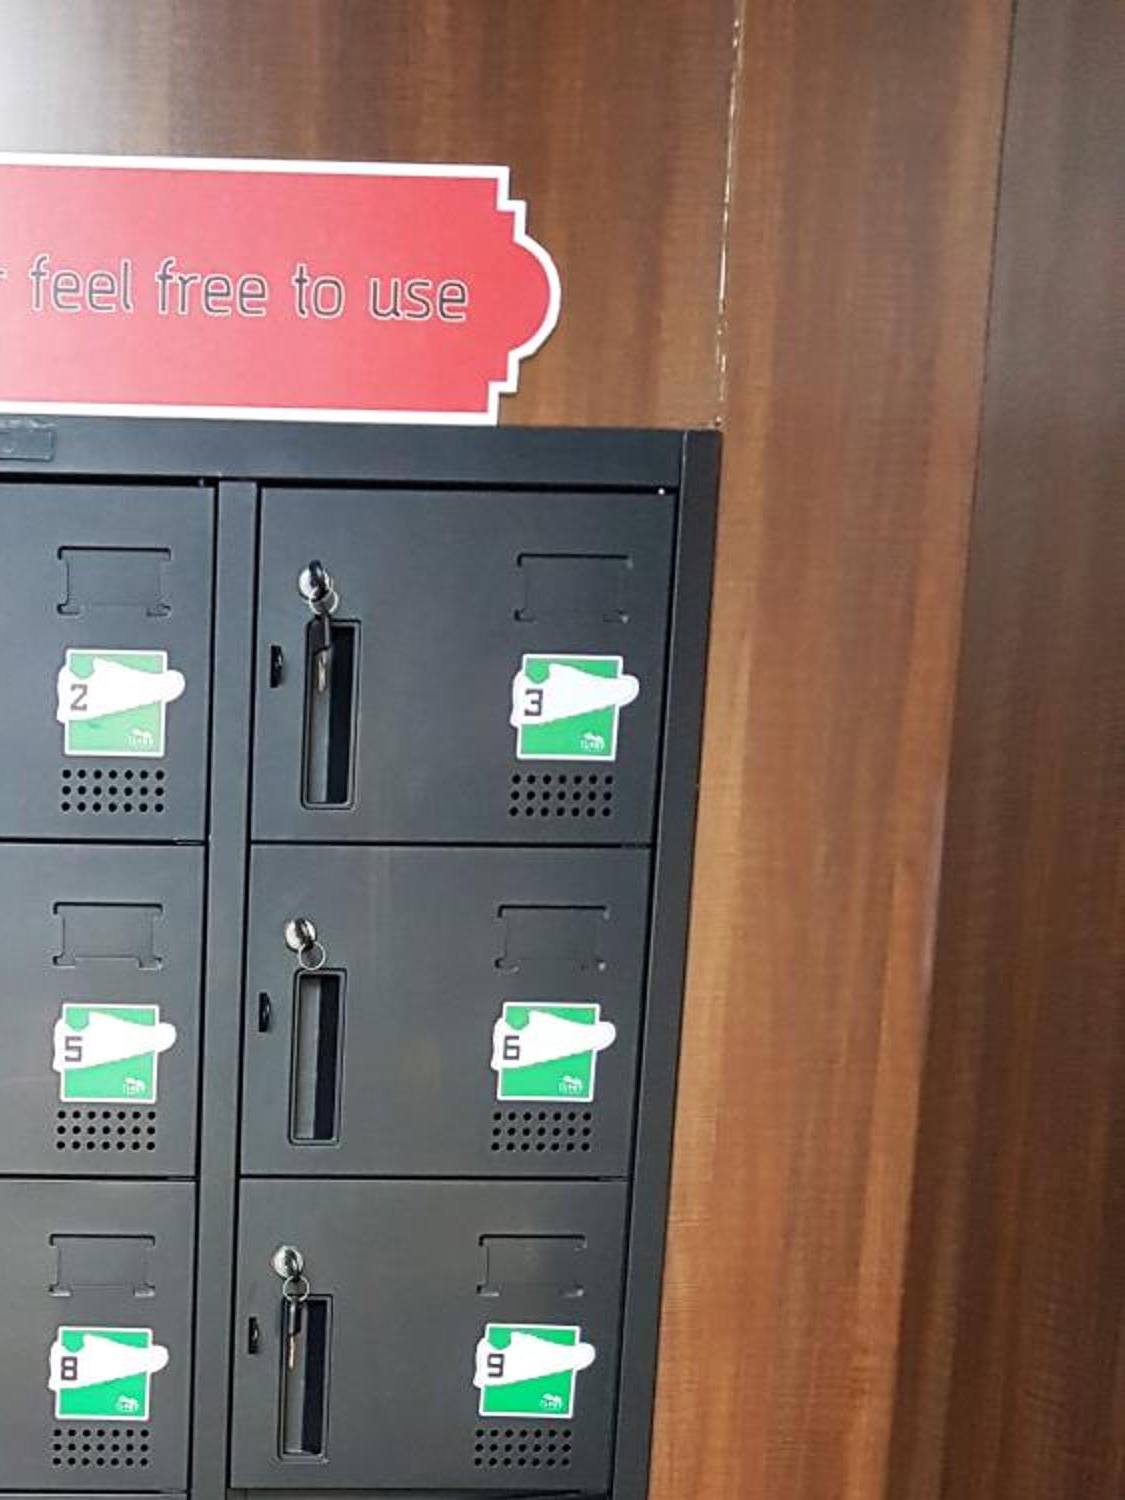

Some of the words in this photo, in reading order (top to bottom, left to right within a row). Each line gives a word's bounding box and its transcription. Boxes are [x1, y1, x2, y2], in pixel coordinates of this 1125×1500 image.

[29, 254, 133, 312] feel
[155, 258, 268, 315] free
[293, 264, 345, 317] to
[370, 277, 468, 320] use
[71, 684, 87, 711] 2
[524, 688, 543, 716] 3
[65, 1036, 82, 1062] 5
[503, 1035, 520, 1060] 6
[60, 1356, 78, 1381] 8
[487, 1353, 505, 1378] 9
